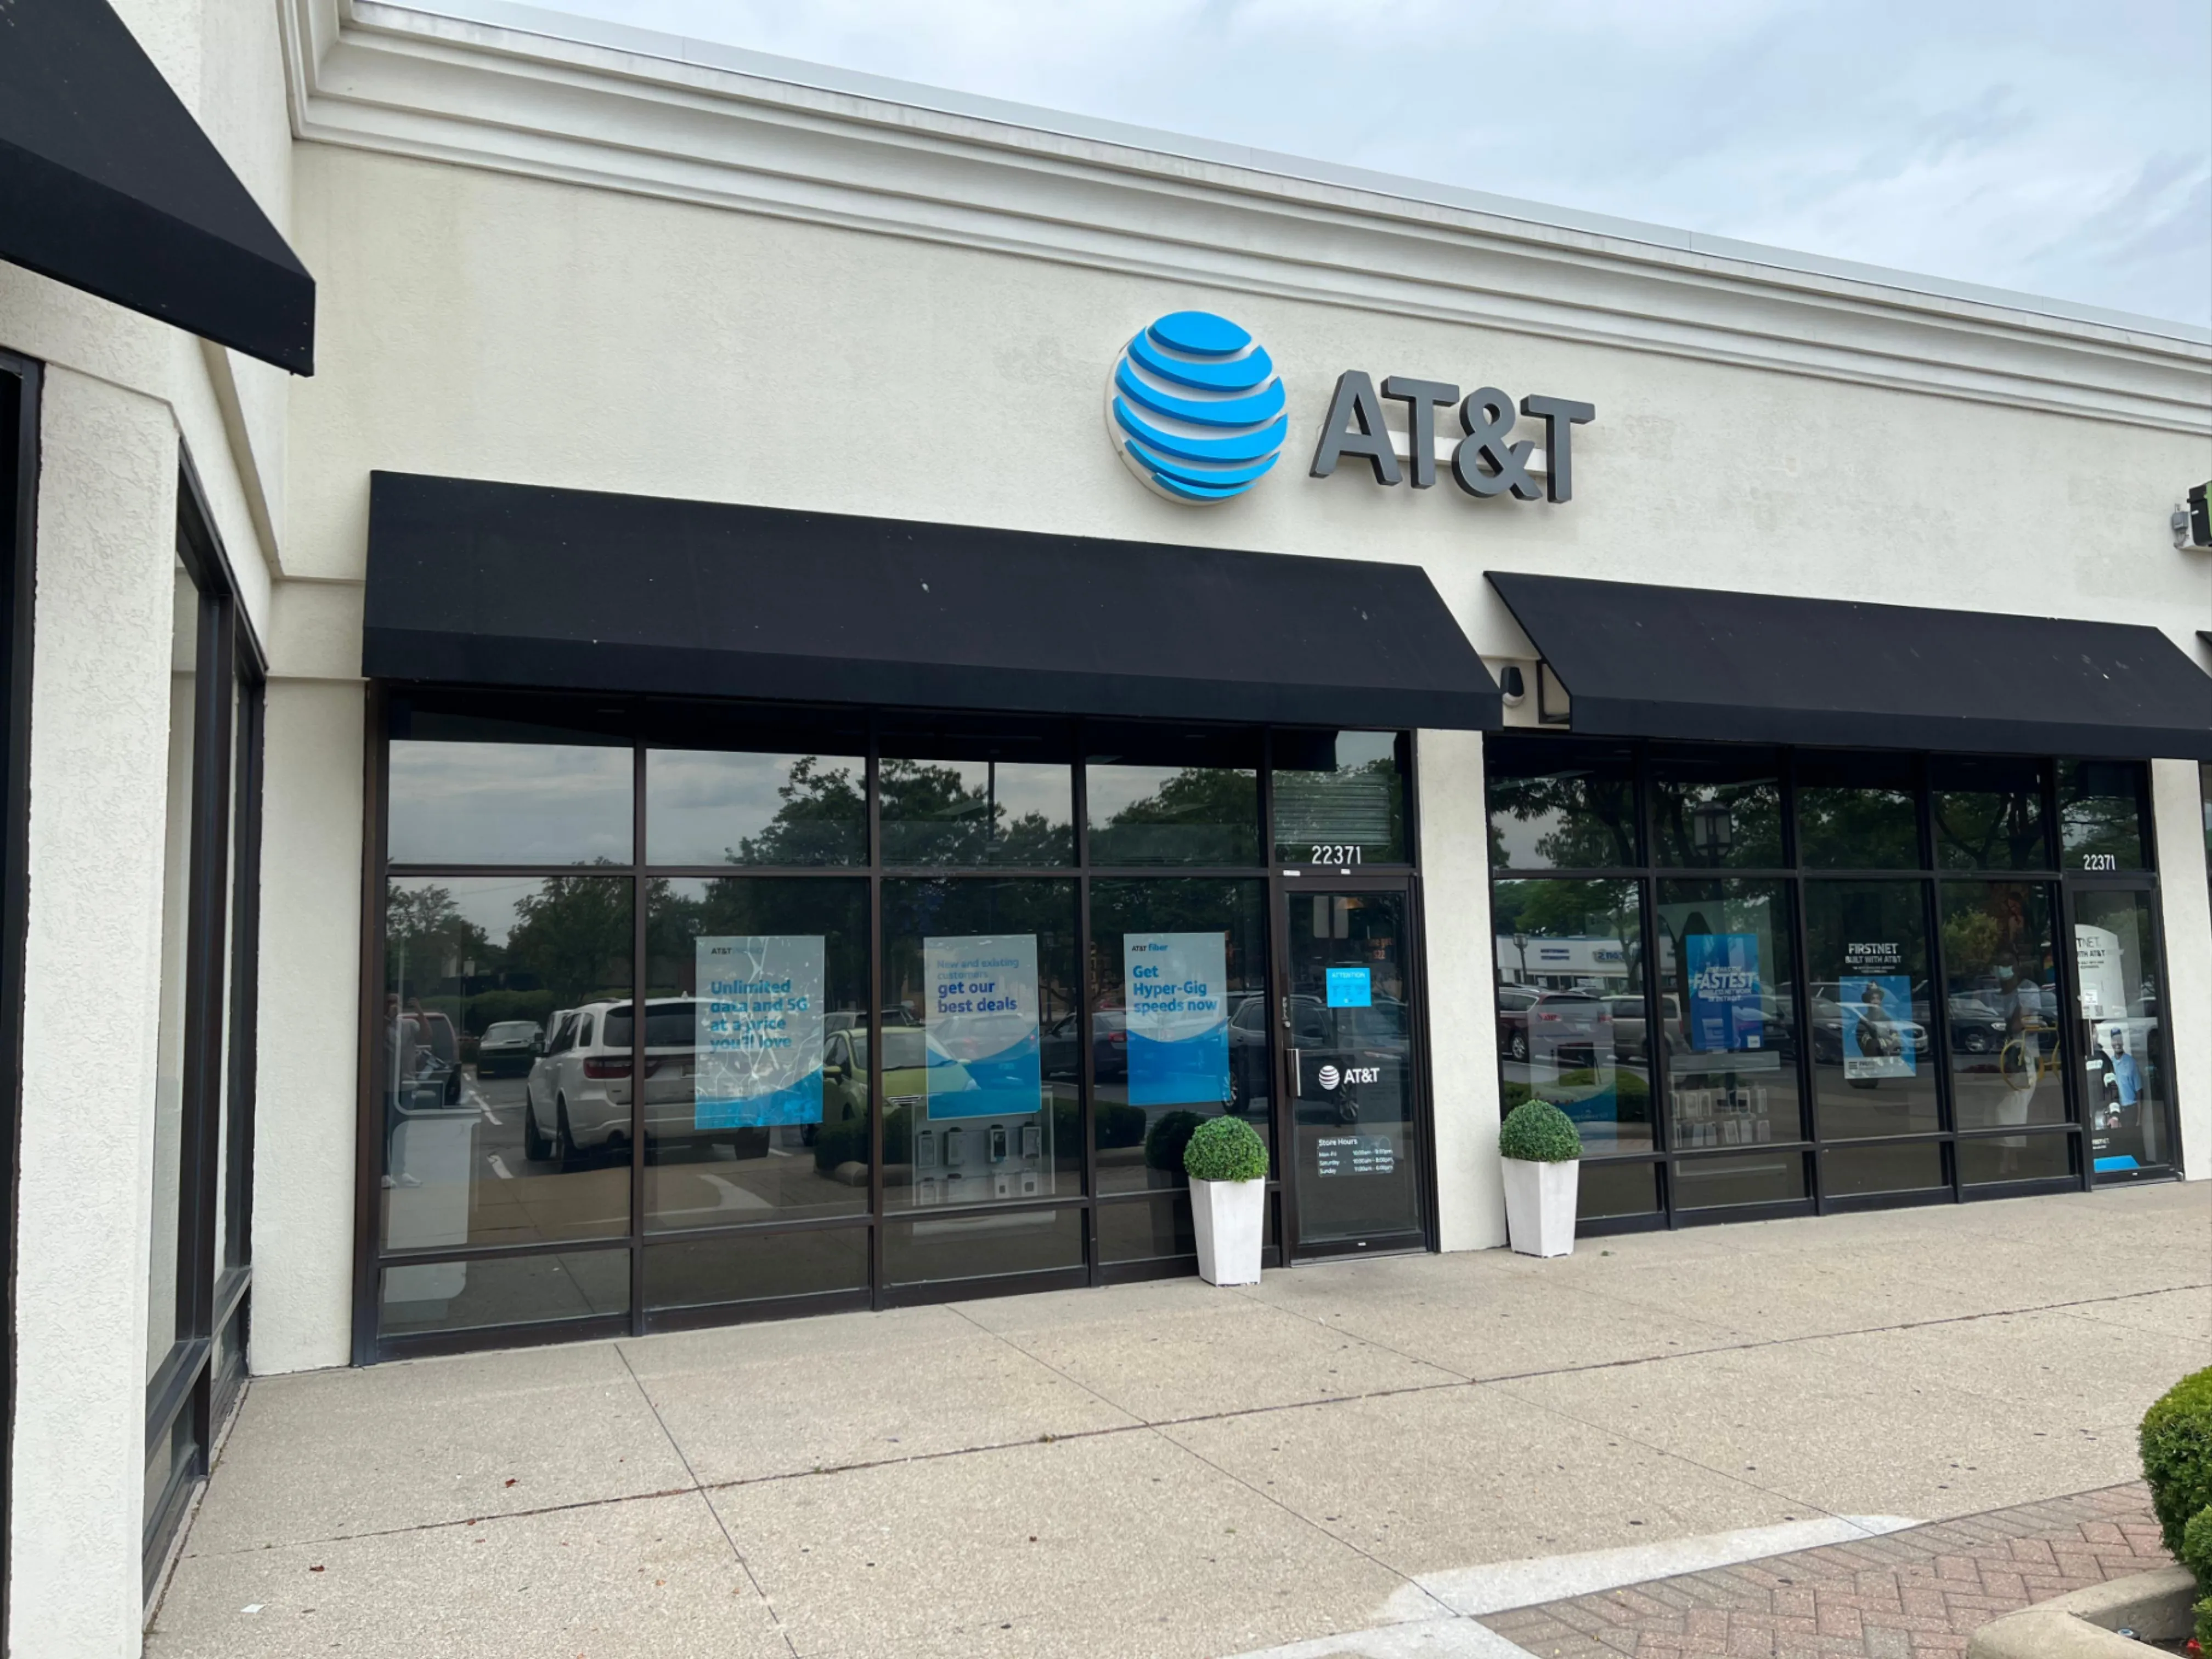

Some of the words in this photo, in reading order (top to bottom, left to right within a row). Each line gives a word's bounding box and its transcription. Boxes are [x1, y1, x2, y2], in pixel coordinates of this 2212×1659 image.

[1309, 370, 1595, 504] AT&T
[1311, 845, 1362, 865] 22371
[2083, 854, 2116, 871] 22371
[711, 947, 733, 955] AT&T
[1848, 943, 1899, 955] FIRSTNET
[937, 960, 959, 969] New
[961, 959, 979, 968] and
[981, 957, 1019, 969] existing
[1864, 955, 1883, 964] WITH
[1884, 955, 1902, 964] AT&T
[1132, 965, 1159, 979] Get
[710, 979, 792, 995] Unlimited
[1694, 972, 1756, 990] FASTEST
[938, 981, 964, 998] get
[969, 982, 995, 994] our
[1133, 980, 1207, 999] Hyper-Gig
[752, 997, 784, 1012] and
[787, 996, 809, 1012] 5G
[938, 998, 973, 1013] best
[977, 996, 1018, 1012] deals
[1133, 998, 1184, 1015] speeds
[1187, 998, 1218, 1012] now
[710, 1018, 727, 1032] at
[732, 1020, 741, 1031] a
[746, 1016, 787, 1033] price
[759, 1034, 792, 1048] love
[1344, 1068, 1380, 1084] AT&T
